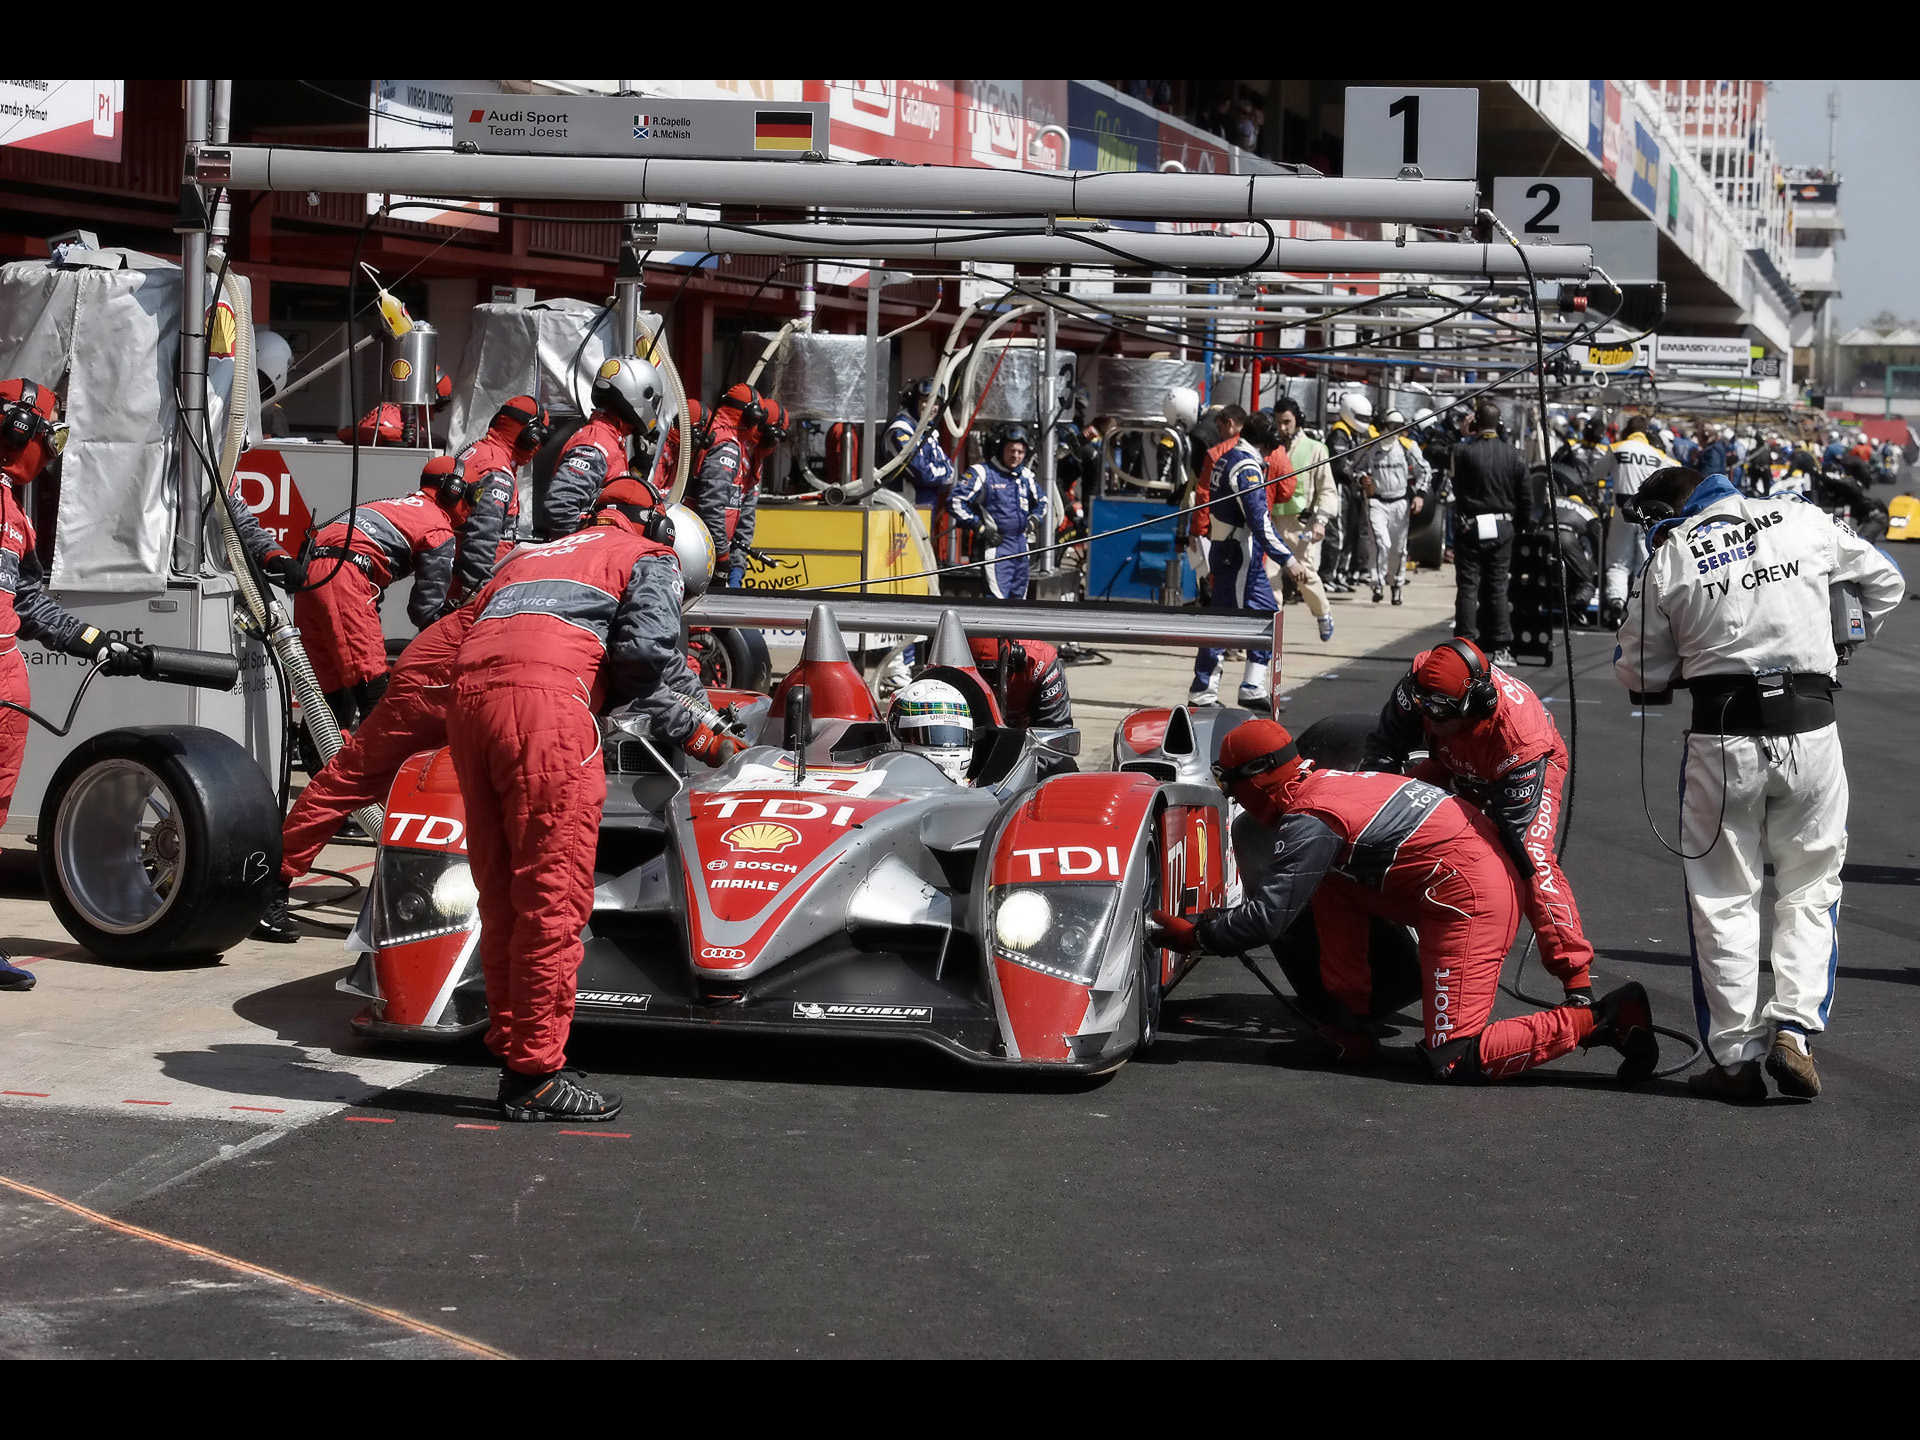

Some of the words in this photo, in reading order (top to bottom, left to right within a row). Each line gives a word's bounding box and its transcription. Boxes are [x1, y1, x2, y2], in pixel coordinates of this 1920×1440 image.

[0, 101, 23, 117] xandre
[98, 93, 110, 121] P1
[407, 85, 427, 109] VIRGO
[428, 91, 453, 114] MOTORS
[488, 110, 523, 122] Audi
[527, 111, 568, 124] Sport
[652, 116, 691, 127] R.Capello
[488, 125, 526, 136] Team
[530, 126, 568, 138] Joest
[652, 130, 691, 139] A.McNish
[1389, 95, 1420, 164] 1
[1524, 183, 1561, 233] 2
[235, 471, 291, 515] DI
[1690, 540, 1715, 559] LE
[1723, 510, 1783, 547] MANS
[1697, 540, 1757, 575] SERIES
[745, 574, 802, 590] Power
[1703, 579, 1730, 600] TV
[1741, 560, 1800, 591] CREW
[496, 595, 558, 610] Service
[22, 651, 67, 666] eam
[929, 713, 960, 721] UNIPART
[704, 798, 855, 827] TDI
[1530, 787, 1555, 840] Sport
[733, 860, 798, 874] BOSCH
[1013, 846, 1120, 877] TDI
[1528, 842, 1560, 894] Audi
[710, 879, 780, 891] MAHLE
[575, 992, 646, 1003] CHELIN
[1432, 968, 1454, 1048] Sport
[826, 1005, 929, 1016] MICHELIN
